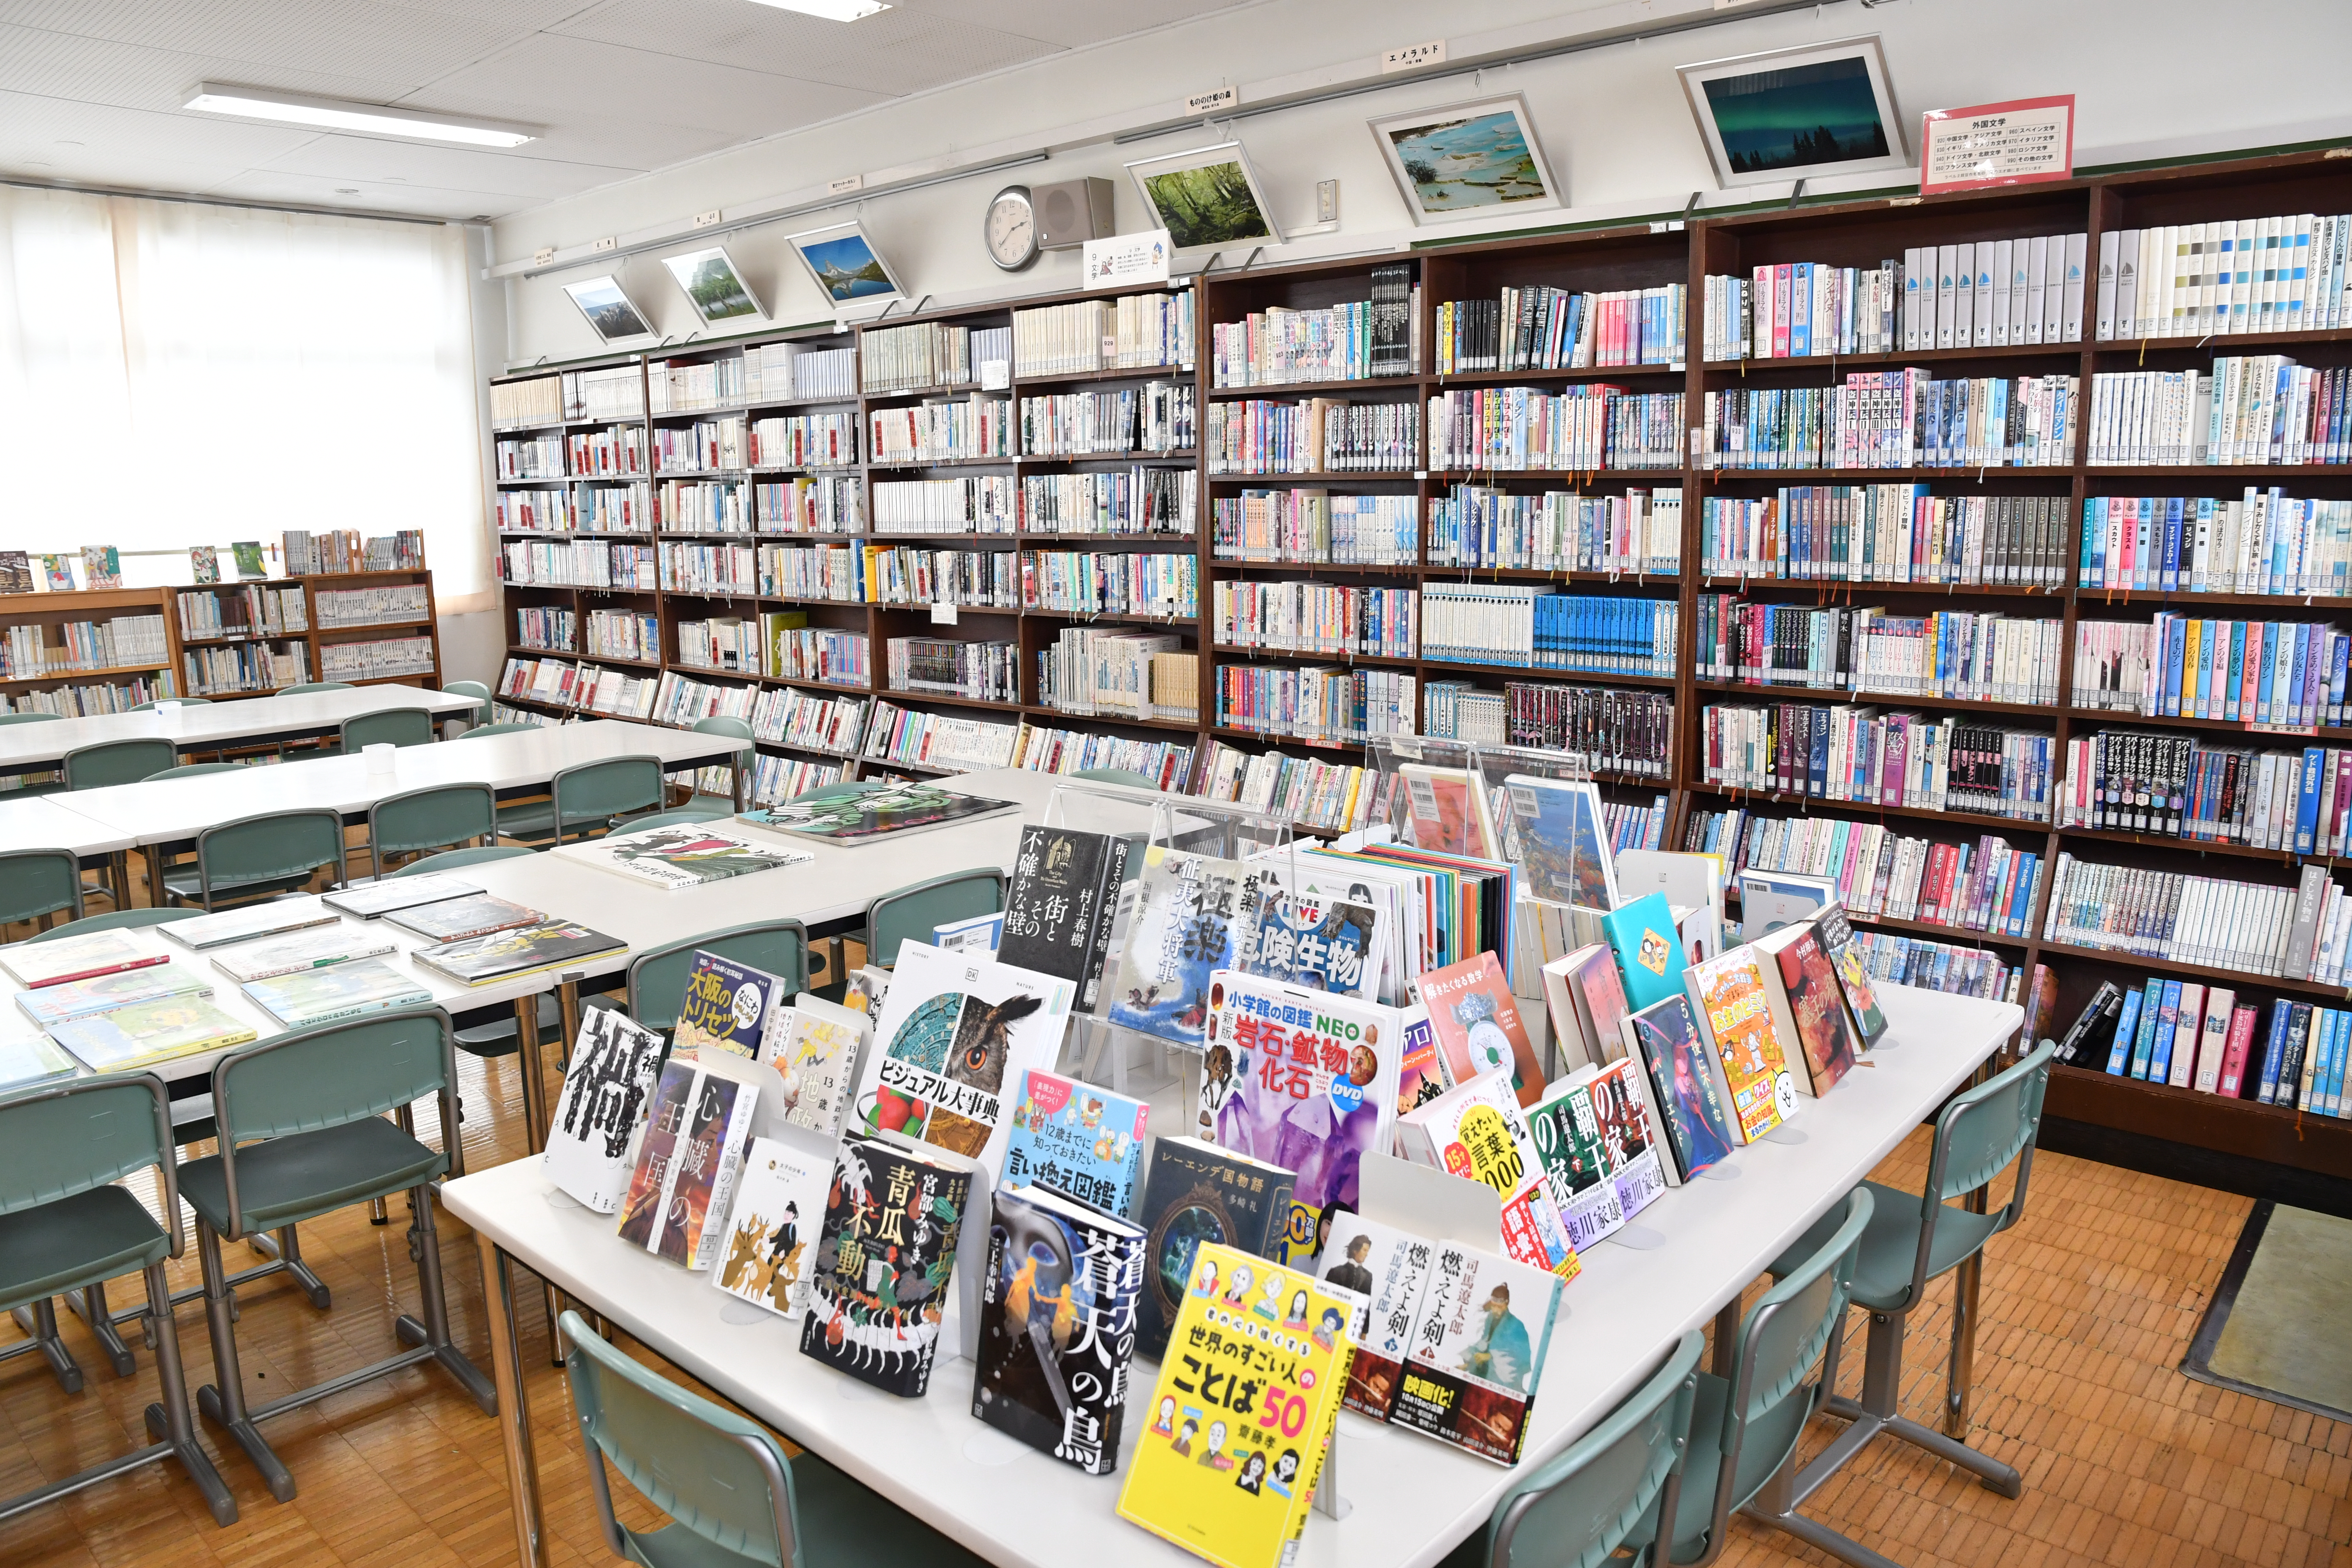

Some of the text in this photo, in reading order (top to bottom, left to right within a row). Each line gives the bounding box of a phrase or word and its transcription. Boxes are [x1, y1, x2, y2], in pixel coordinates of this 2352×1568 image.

[1389, 45, 1437, 61] エメラルド
[1190, 90, 1230, 106] もののけ姫の森
[1946, 131, 2002, 142] 中国文学・アジア文学
[1972, 118, 2006, 129] 外国文学
[1946, 150, 2001, 161] ドイツ文学・北欧文学
[1092, 264, 1097, 280] 文学
[2253, 364, 2263, 399] 小さな魚
[1901, 488, 1909, 530] ホビットの冒険
[2172, 635, 2182, 667] 赤毛のアン
[2187, 637, 2196, 669] アンの青春
[2201, 639, 2210, 670] アンの愛情
[2216, 639, 2226, 670] アンの幸福
[2231, 640, 2242, 677] アンの夢の家
[2246, 640, 2257, 684] アンの愛の家庭
[2262, 641, 2273, 678] 虹の谷のアン
[2279, 642, 2289, 679] アンの娘リラ
[2294, 643, 2305, 682] アンの友だち
[2307, 642, 2319, 695] アンをめぐる人々
[2066, 744, 2077, 788] エミリーへの手紙
[1005, 830, 1044, 936] 不確かな壁
[1096, 843, 1128, 952] 街とその不確かな壁
[1136, 881, 1153, 925] 垣根涼介
[1240, 874, 1260, 913] 極楽
[2300, 871, 2317, 923] はてしない物語
[1025, 901, 1041, 937] その
[1045, 895, 1069, 942] 街と
[1070, 889, 1093, 948] 村上春樹
[1156, 855, 1203, 983] 征夷大将軍
[1184, 873, 1236, 964] 極楽
[699, 958, 710, 966] 地図で
[912, 951, 929, 959] HISTORY
[1796, 937, 1816, 960] 今村翔吾
[688, 968, 732, 1008] 大阪の
[968, 971, 976, 979] DK
[1016, 982, 1034, 991] NATURE
[1094, 962, 1102, 981] 村上
[1424, 969, 1483, 1000] 解きたくなる数学
[1714, 973, 1752, 1002] にゃんこ大戦争
[738, 989, 758, 1014] なにわ
[1262, 993, 1281, 1001] NATURE
[1305, 1004, 1326, 1013] ORIGIN
[1712, 989, 1766, 1034] お金のヒミツ
[1726, 985, 1746, 1001] でまなぶ!
[1799, 972, 1839, 1027] 塞王の楯
[299, 1007, 362, 1025] バムとケロのおかいもの
[682, 995, 740, 1039] トリセツ
[1221, 1011, 1233, 1041] 新版
[1229, 991, 1359, 1041] 小学館の図鑑 NEO
[642, 1055, 658, 1073] 禍
[1233, 1014, 1348, 1076] 岩石・鉱物
[1679, 1002, 1723, 1122] 5分後に不幸な
[833, 1045, 856, 1123] 13歳からの地政学
[879, 1060, 1000, 1124] ビジュアル大事典
[1034, 1091, 1059, 1105] 差がつく!
[1258, 1057, 1312, 1100] 化石
[1332, 1083, 1362, 1100] DVD
[737, 1094, 751, 1132] 竹宮ゆゆこ
[1620, 1060, 1654, 1149] 覇王
[1654, 1058, 1683, 1147] バッドエンド
[643, 1101, 686, 1192] 王国
[1045, 1124, 1092, 1149] 12歳までに
[1459, 1111, 1497, 1146] 覚えたい
[1568, 1087, 1611, 1183] 覇王
[1594, 1081, 1627, 1172] の家
[670, 1085, 719, 1227] 心臓の
[1033, 1135, 1096, 1165] 知っておきたい
[1472, 1132, 1505, 1171] 言葉
[1535, 1112, 1573, 1204] の家
[711, 1140, 741, 1217] 心臓の王国
[1009, 1146, 1116, 1211] 言い換え図鑑
[1162, 1152, 1264, 1193] レーエンデ国物語
[1621, 1165, 1663, 1214] 徳川家康
[875, 1165, 916, 1246] 青瓜
[911, 1174, 939, 1264] 宮部みゆき
[1229, 1194, 1257, 1212] 多崎 礼
[836, 1201, 874, 1281] 不動
[984, 1238, 1000, 1304] 三上幸四郎
[1376, 1239, 1407, 1313] 司馬遼太郎
[1386, 1243, 1429, 1337] 燃えよ剣
[1421, 1249, 1463, 1346] 燃えよ剣
[1448, 1257, 1479, 1335] 司馬遼太郎
[1104, 1239, 1147, 1407] 蒼天の鳥
[1205, 1307, 1311, 1358] 君の心を強くする
[1054, 1228, 1122, 1475] 蒼天の鳥
[1403, 1374, 1455, 1409] 映画化!
